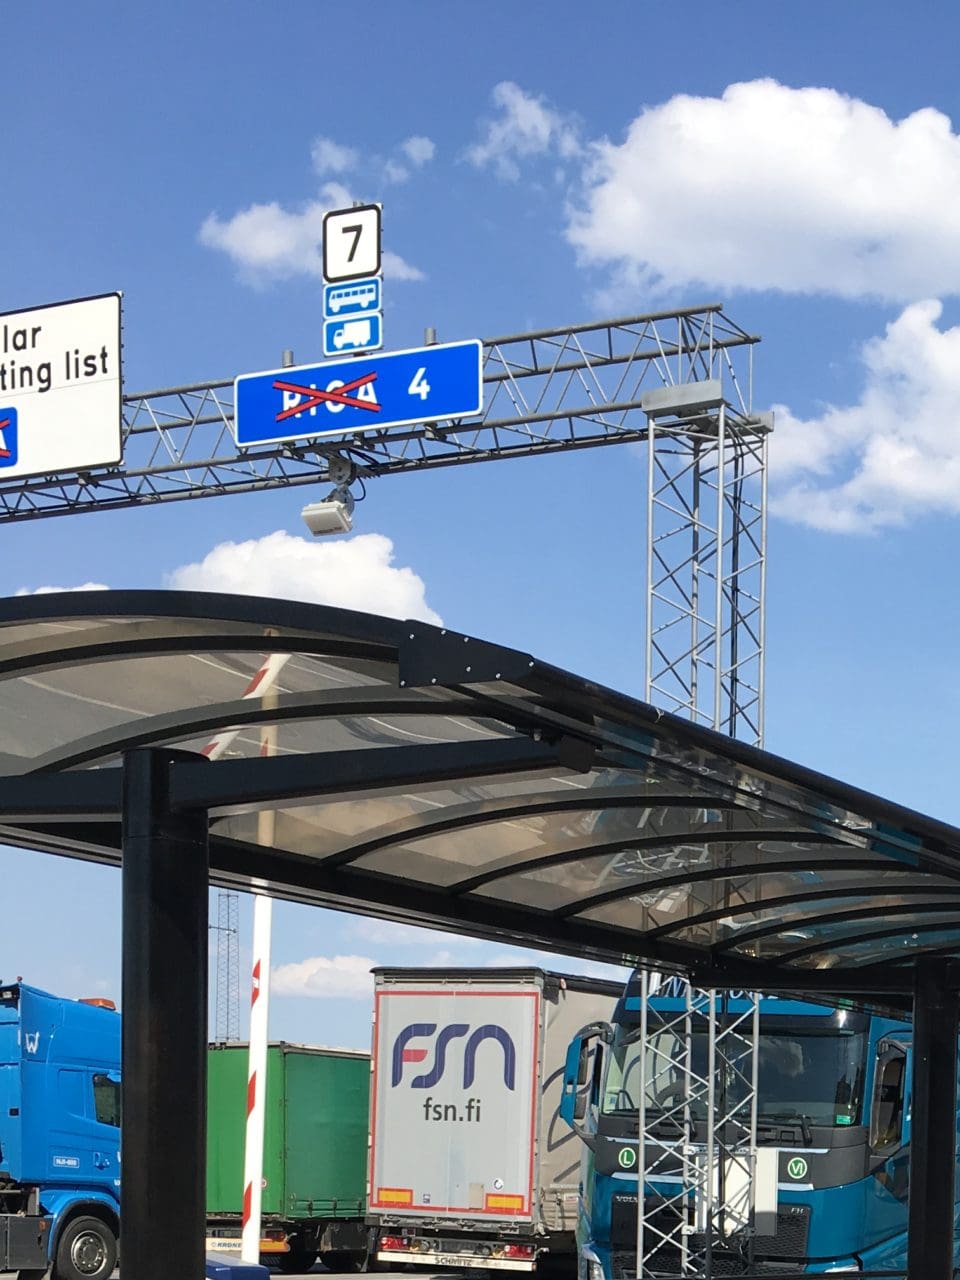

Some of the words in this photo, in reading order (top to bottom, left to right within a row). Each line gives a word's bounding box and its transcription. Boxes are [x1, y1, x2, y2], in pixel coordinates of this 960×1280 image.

[342, 224, 363, 262] 7
[3, 324, 42, 353] lar
[66, 345, 108, 380] list
[407, 367, 431, 400] 4
[423, 1097, 480, 1122] fsn.fi
